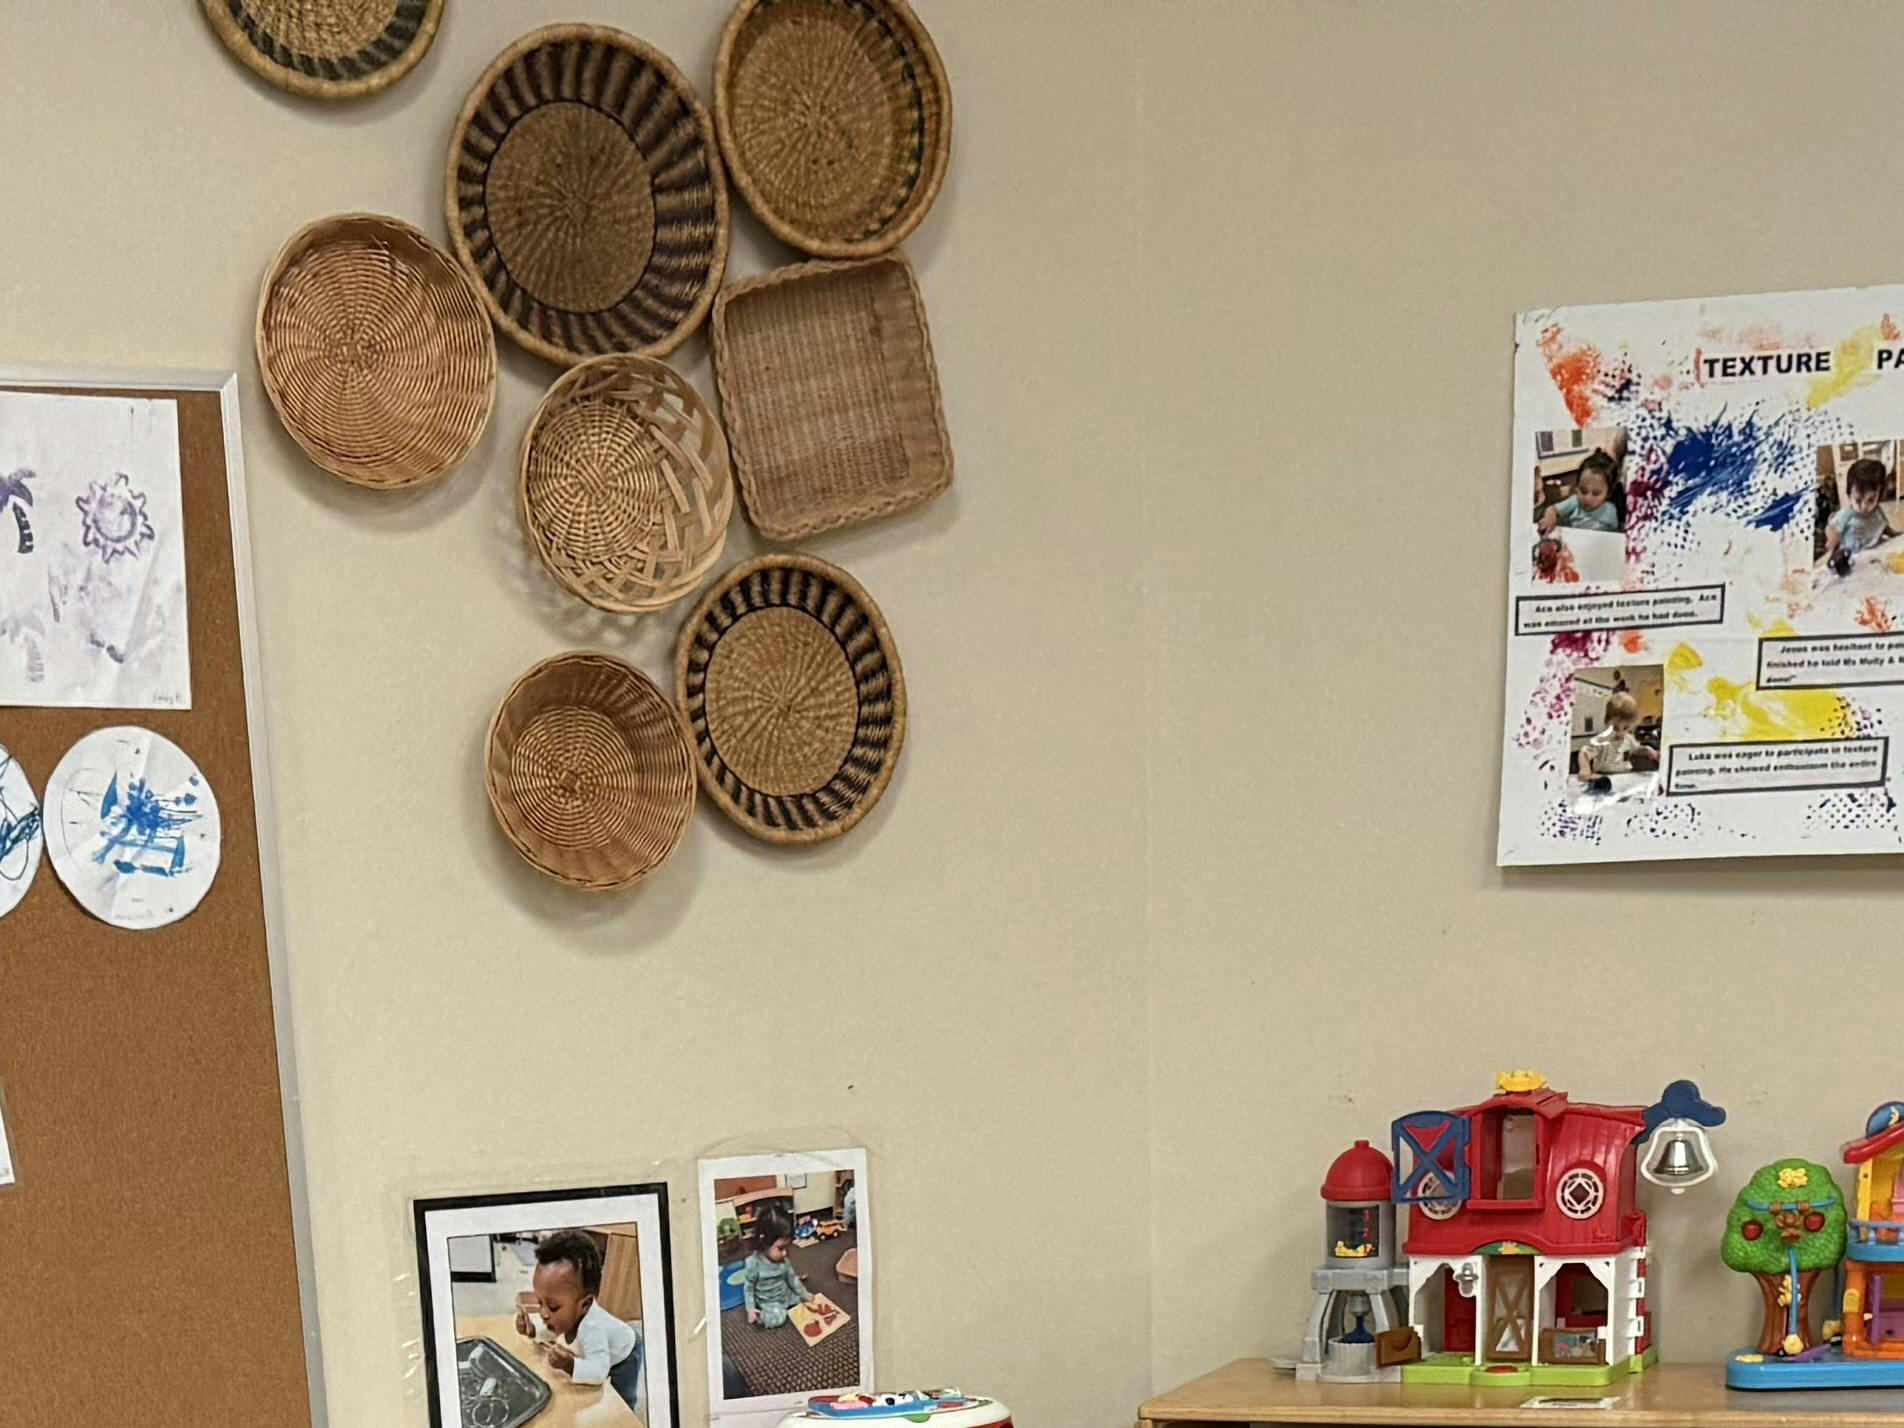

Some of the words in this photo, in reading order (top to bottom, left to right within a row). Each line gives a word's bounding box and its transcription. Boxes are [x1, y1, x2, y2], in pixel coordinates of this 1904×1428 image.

[1702, 350, 1832, 379] TEXTURE
[1554, 603, 1575, 612] also
[1577, 600, 1614, 611] enjoyed
[1616, 598, 1650, 608] texture
[1594, 616, 1610, 624] the
[1652, 611, 1670, 619] had
[1832, 642, 1872, 652] hesitant
[1875, 642, 1885, 650] to
[1766, 660, 1805, 668] finished
[1821, 658, 1841, 667] told
[1735, 751, 1763, 760] eager
[1776, 747, 1829, 757] participate
[1843, 745, 1878, 753] texture
[1734, 764, 1771, 773] showed
[1830, 761, 1846, 769] the
[1848, 760, 1877, 768] entire
